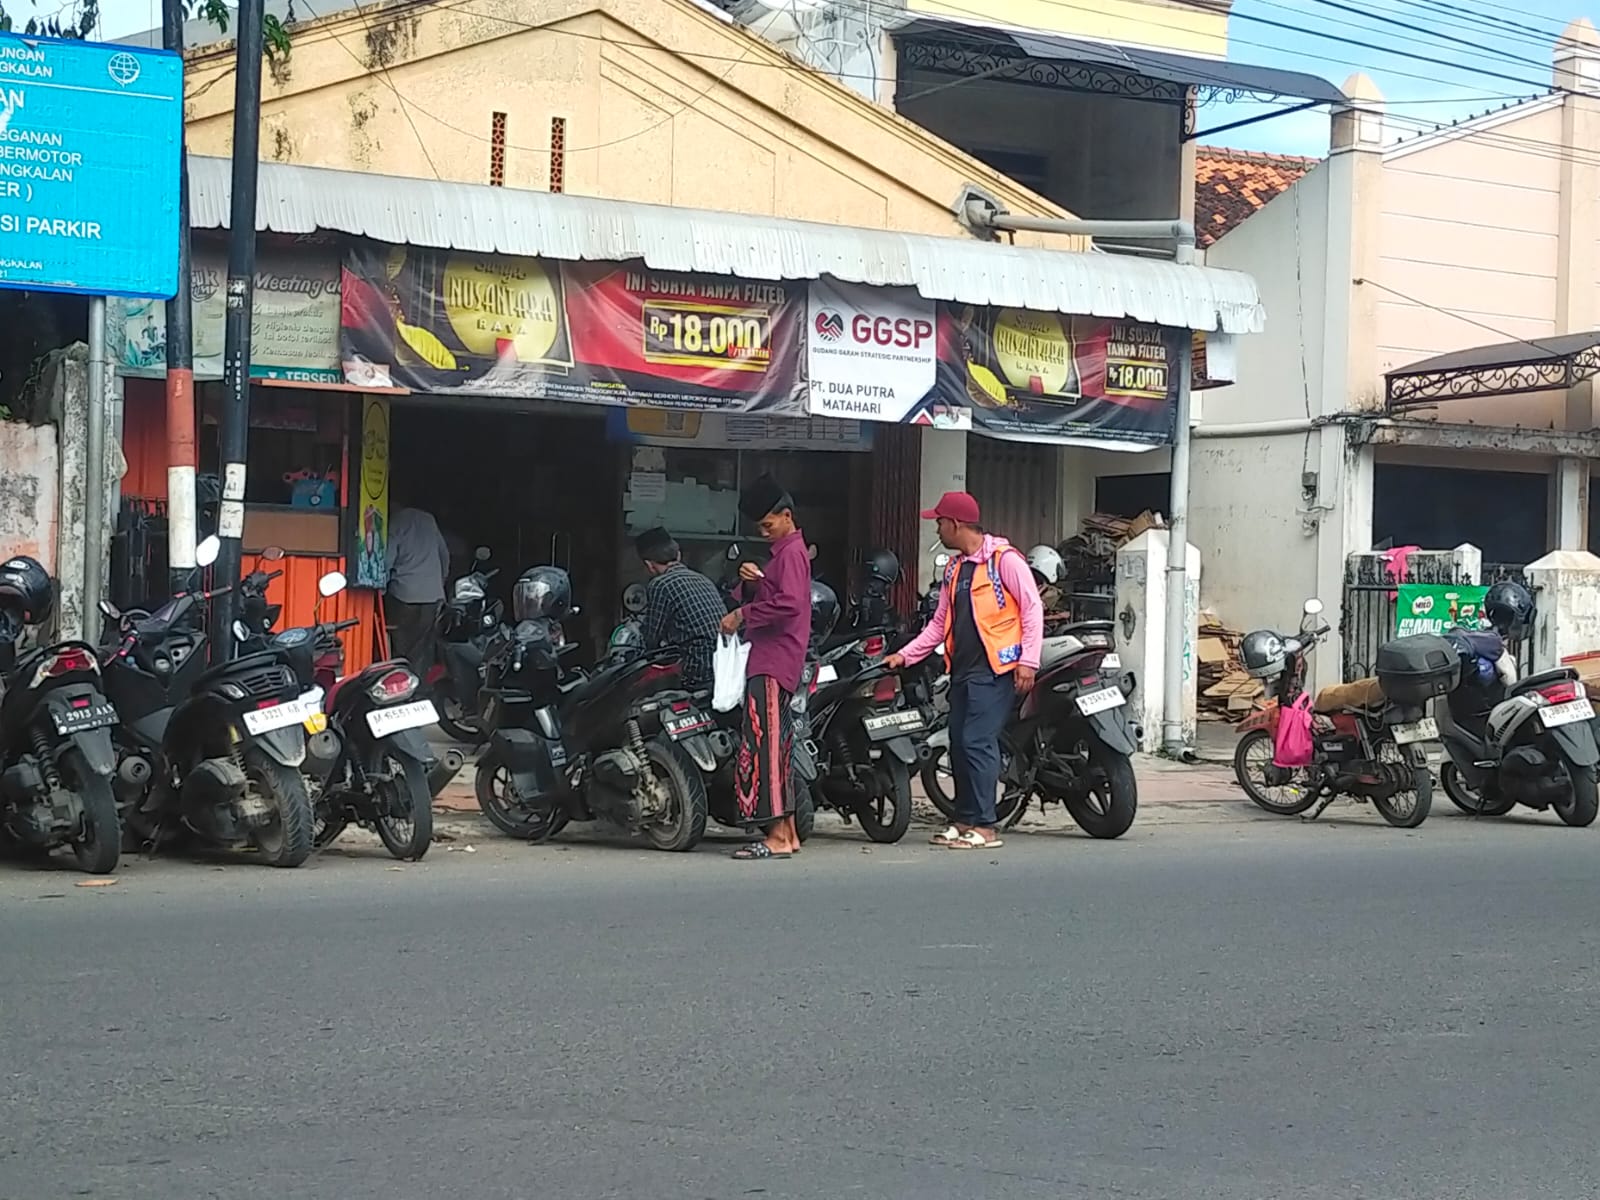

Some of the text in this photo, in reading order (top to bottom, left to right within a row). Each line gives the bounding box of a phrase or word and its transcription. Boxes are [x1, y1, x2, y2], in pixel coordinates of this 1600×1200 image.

[26, 216, 102, 240] PARKIR
[252, 271, 323, 300] Meeting
[625, 272, 646, 291] INI
[701, 282, 740, 301] TANPA
[744, 285, 785, 304] FILTER
[449, 276, 553, 322] NUSANTARA
[476, 318, 528, 335] RAYA
[650, 315, 668, 342] Rp
[669, 313, 762, 354] 18.000
[851, 313, 933, 349] GGSP
[1128, 326, 1162, 344] SURYA
[812, 346, 932, 364] GUDANG GARAM STRATEGIC PARTNERSHIP
[1106, 341, 1166, 360] TANPA FILTER
[1118, 365, 1164, 389] 18.000
[810, 379, 896, 399] PT. DUA PUTRA
[822, 398, 881, 414] MATAHARI
[1413, 618, 1442, 636] MILO
[65, 708, 92, 722] 2913
